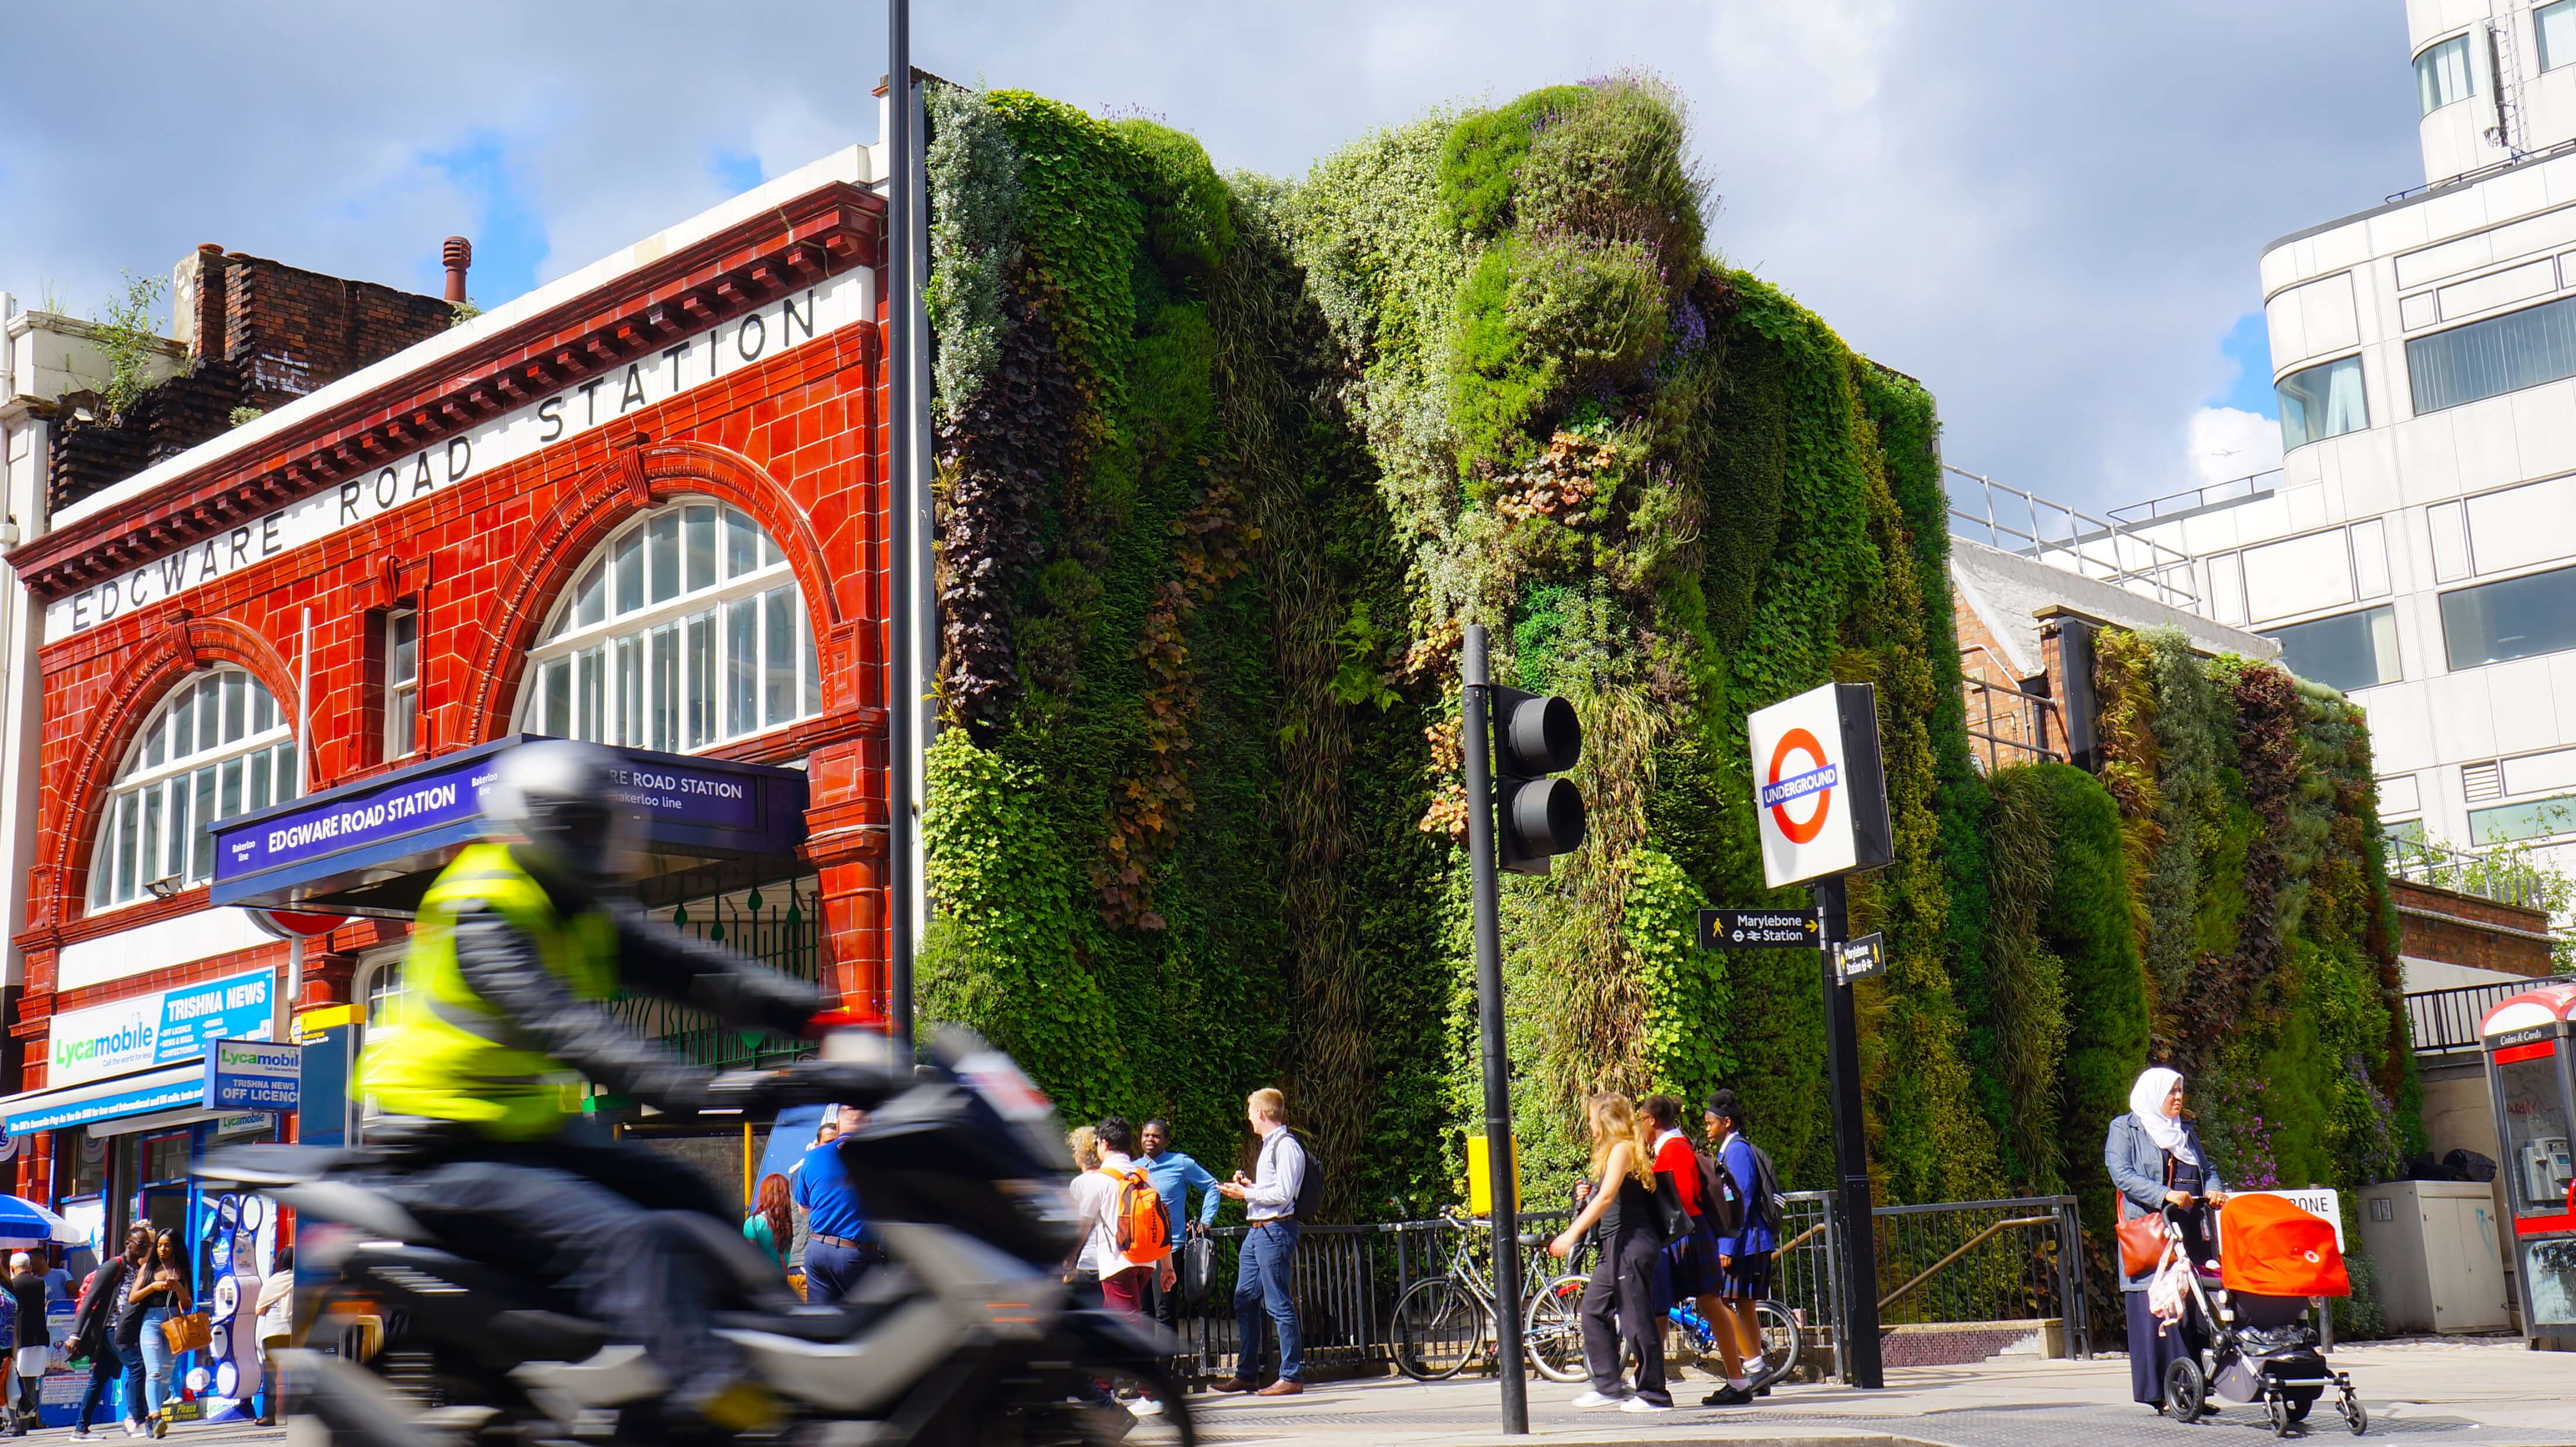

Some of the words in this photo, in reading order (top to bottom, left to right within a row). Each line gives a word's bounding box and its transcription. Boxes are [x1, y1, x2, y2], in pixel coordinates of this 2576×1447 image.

[340, 436, 471, 525] ROAD
[537, 289, 814, 442] STATION
[471, 772, 498, 787] Bakerloo
[633, 772, 676, 790] ROAD
[680, 778, 742, 798] STATION
[1765, 769, 1836, 804] UNDERGROUND
[479, 786, 491, 797] line
[662, 795, 682, 809] line
[268, 815, 338, 853] EDGWARE
[341, 805, 384, 833] ROAD
[388, 783, 456, 820] STATION
[232, 839, 256, 853] Bakerloo
[238, 852, 249, 862] line
[1737, 915, 1802, 929] Marylebone
[1762, 930, 1803, 941] Station
[1844, 945, 1869, 961] Marylebone
[1846, 962, 1862, 975] Station
[167, 990, 224, 1023] TRISHNA
[226, 980, 266, 1010] NEWS
[56, 1021, 153, 1069] Lycamobile
[2500, 1035, 2517, 1045] Coins
[2517, 1033, 2523, 1042] &
[2523, 1029, 2541, 1041] Cards
[102, 1058, 111, 1068] Call
[120, 1054, 134, 1064] world
[142, 1051, 152, 1059] less
[221, 1048, 300, 1067] Lycamobil
[232, 1079, 269, 1089] TRISHNA
[271, 1081, 295, 1091] NEWS
[222, 1088, 248, 1100] OFF
[251, 1089, 300, 1103] LICENC
[223, 1112, 265, 1129] Lycamobile
